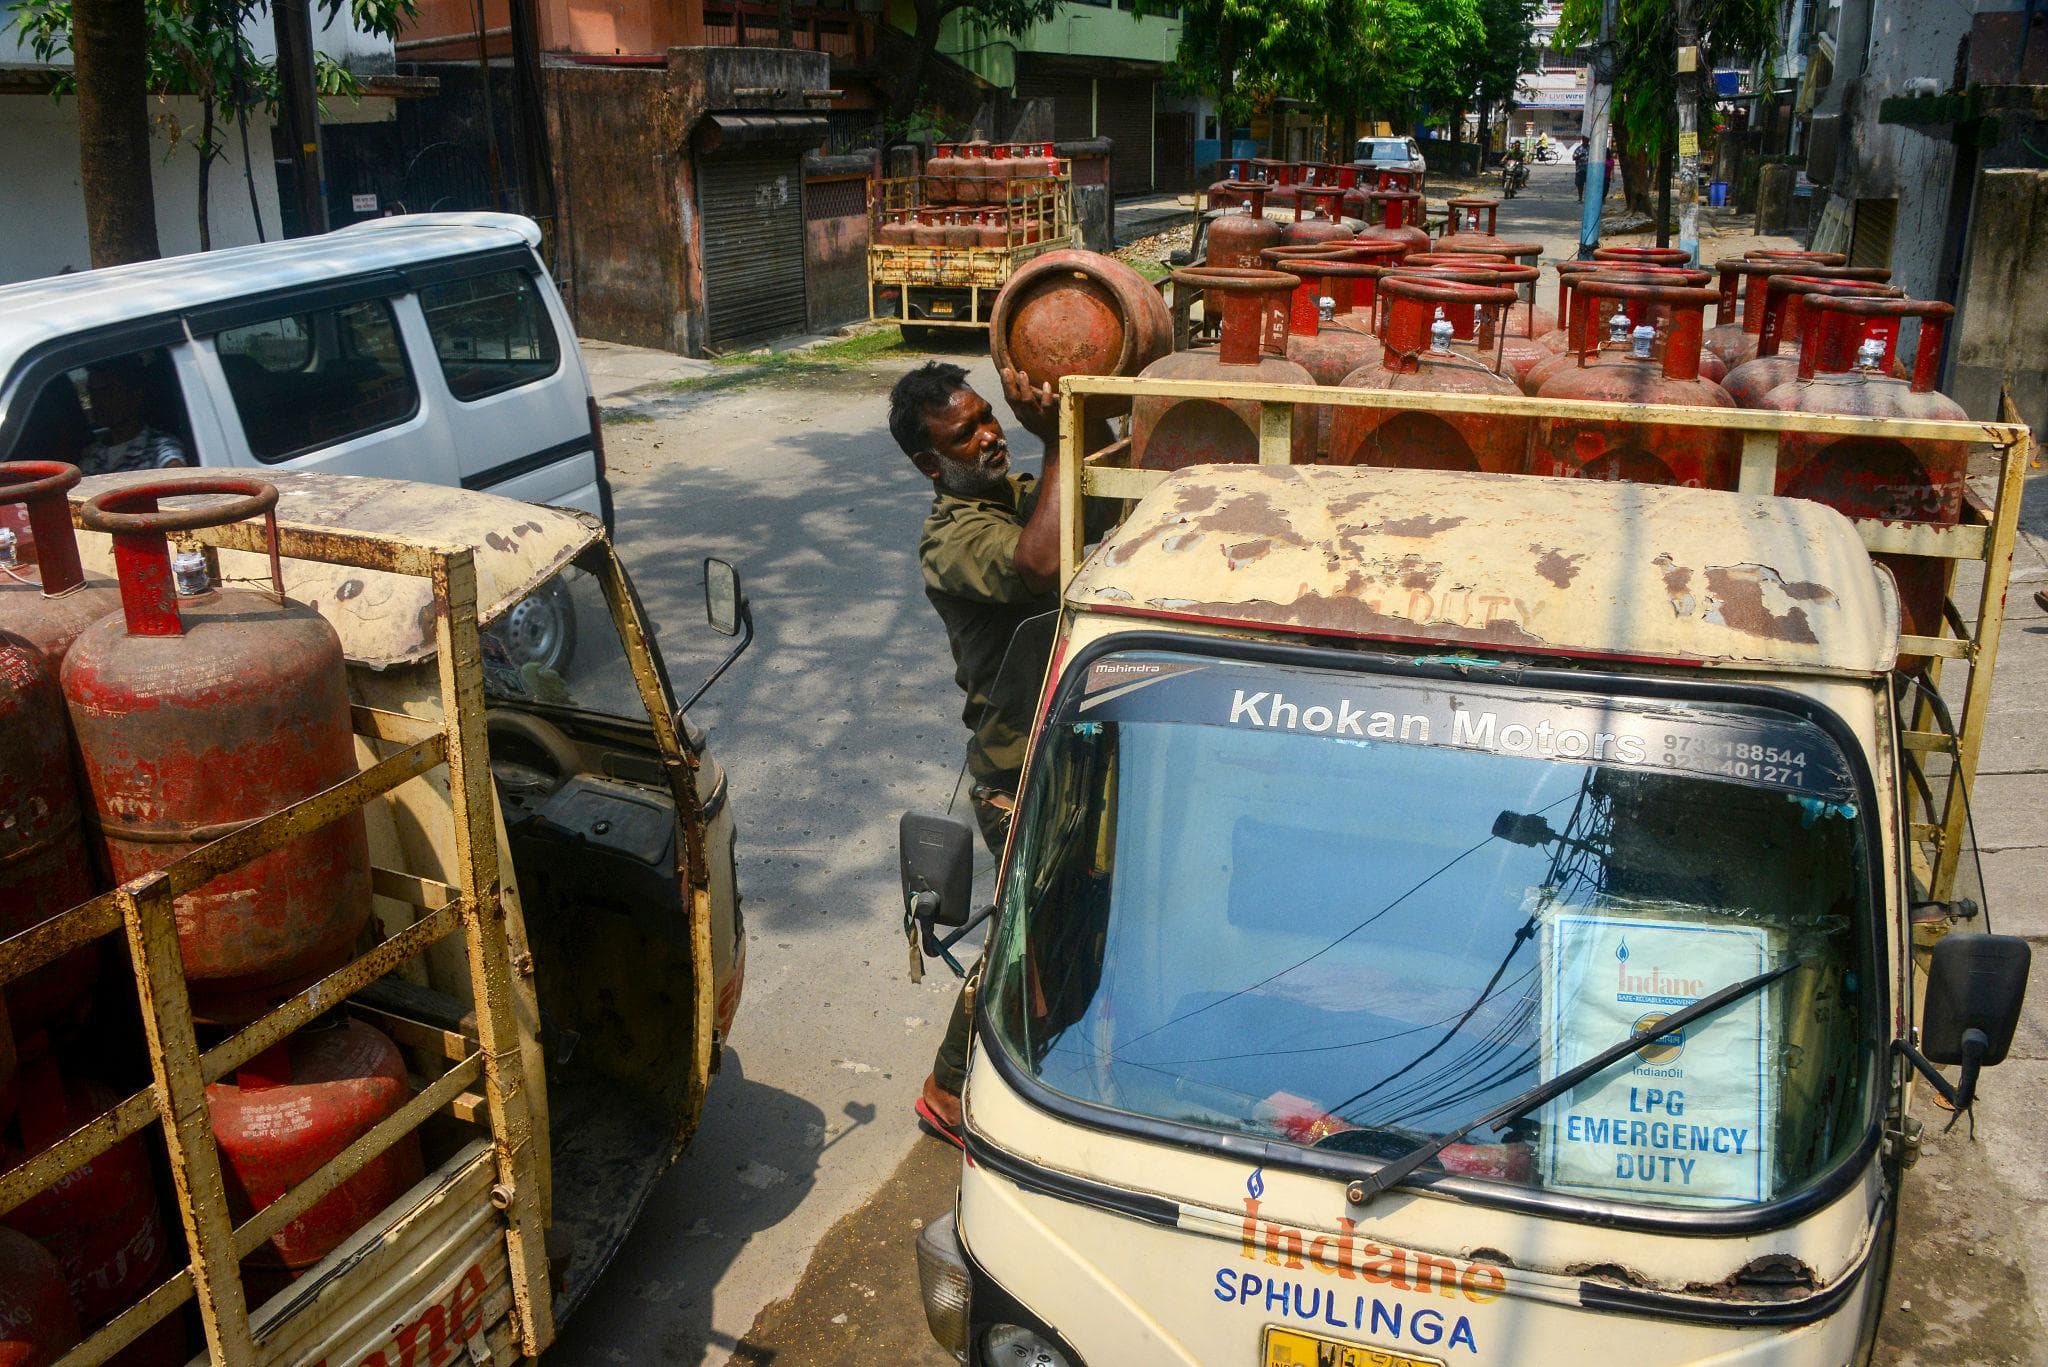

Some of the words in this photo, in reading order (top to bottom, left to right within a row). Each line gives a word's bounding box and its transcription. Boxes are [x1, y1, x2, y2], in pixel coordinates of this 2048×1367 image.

[1272, 309, 1285, 340] 15.7
[1764, 311, 1777, 339] 15.7
[1230, 689, 1431, 746] Khokan
[1450, 709, 1647, 767] Motors
[1618, 964, 1705, 996] Indane
[1632, 1066, 1683, 1079] IndianOil
[1630, 1087, 1684, 1116] LPG
[1567, 1115, 1749, 1154] EMERGENCY
[1616, 1153, 1696, 1185] DUTY
[1240, 1197, 1508, 1305] Indane
[1213, 1268, 1478, 1354] SPHULINGA
